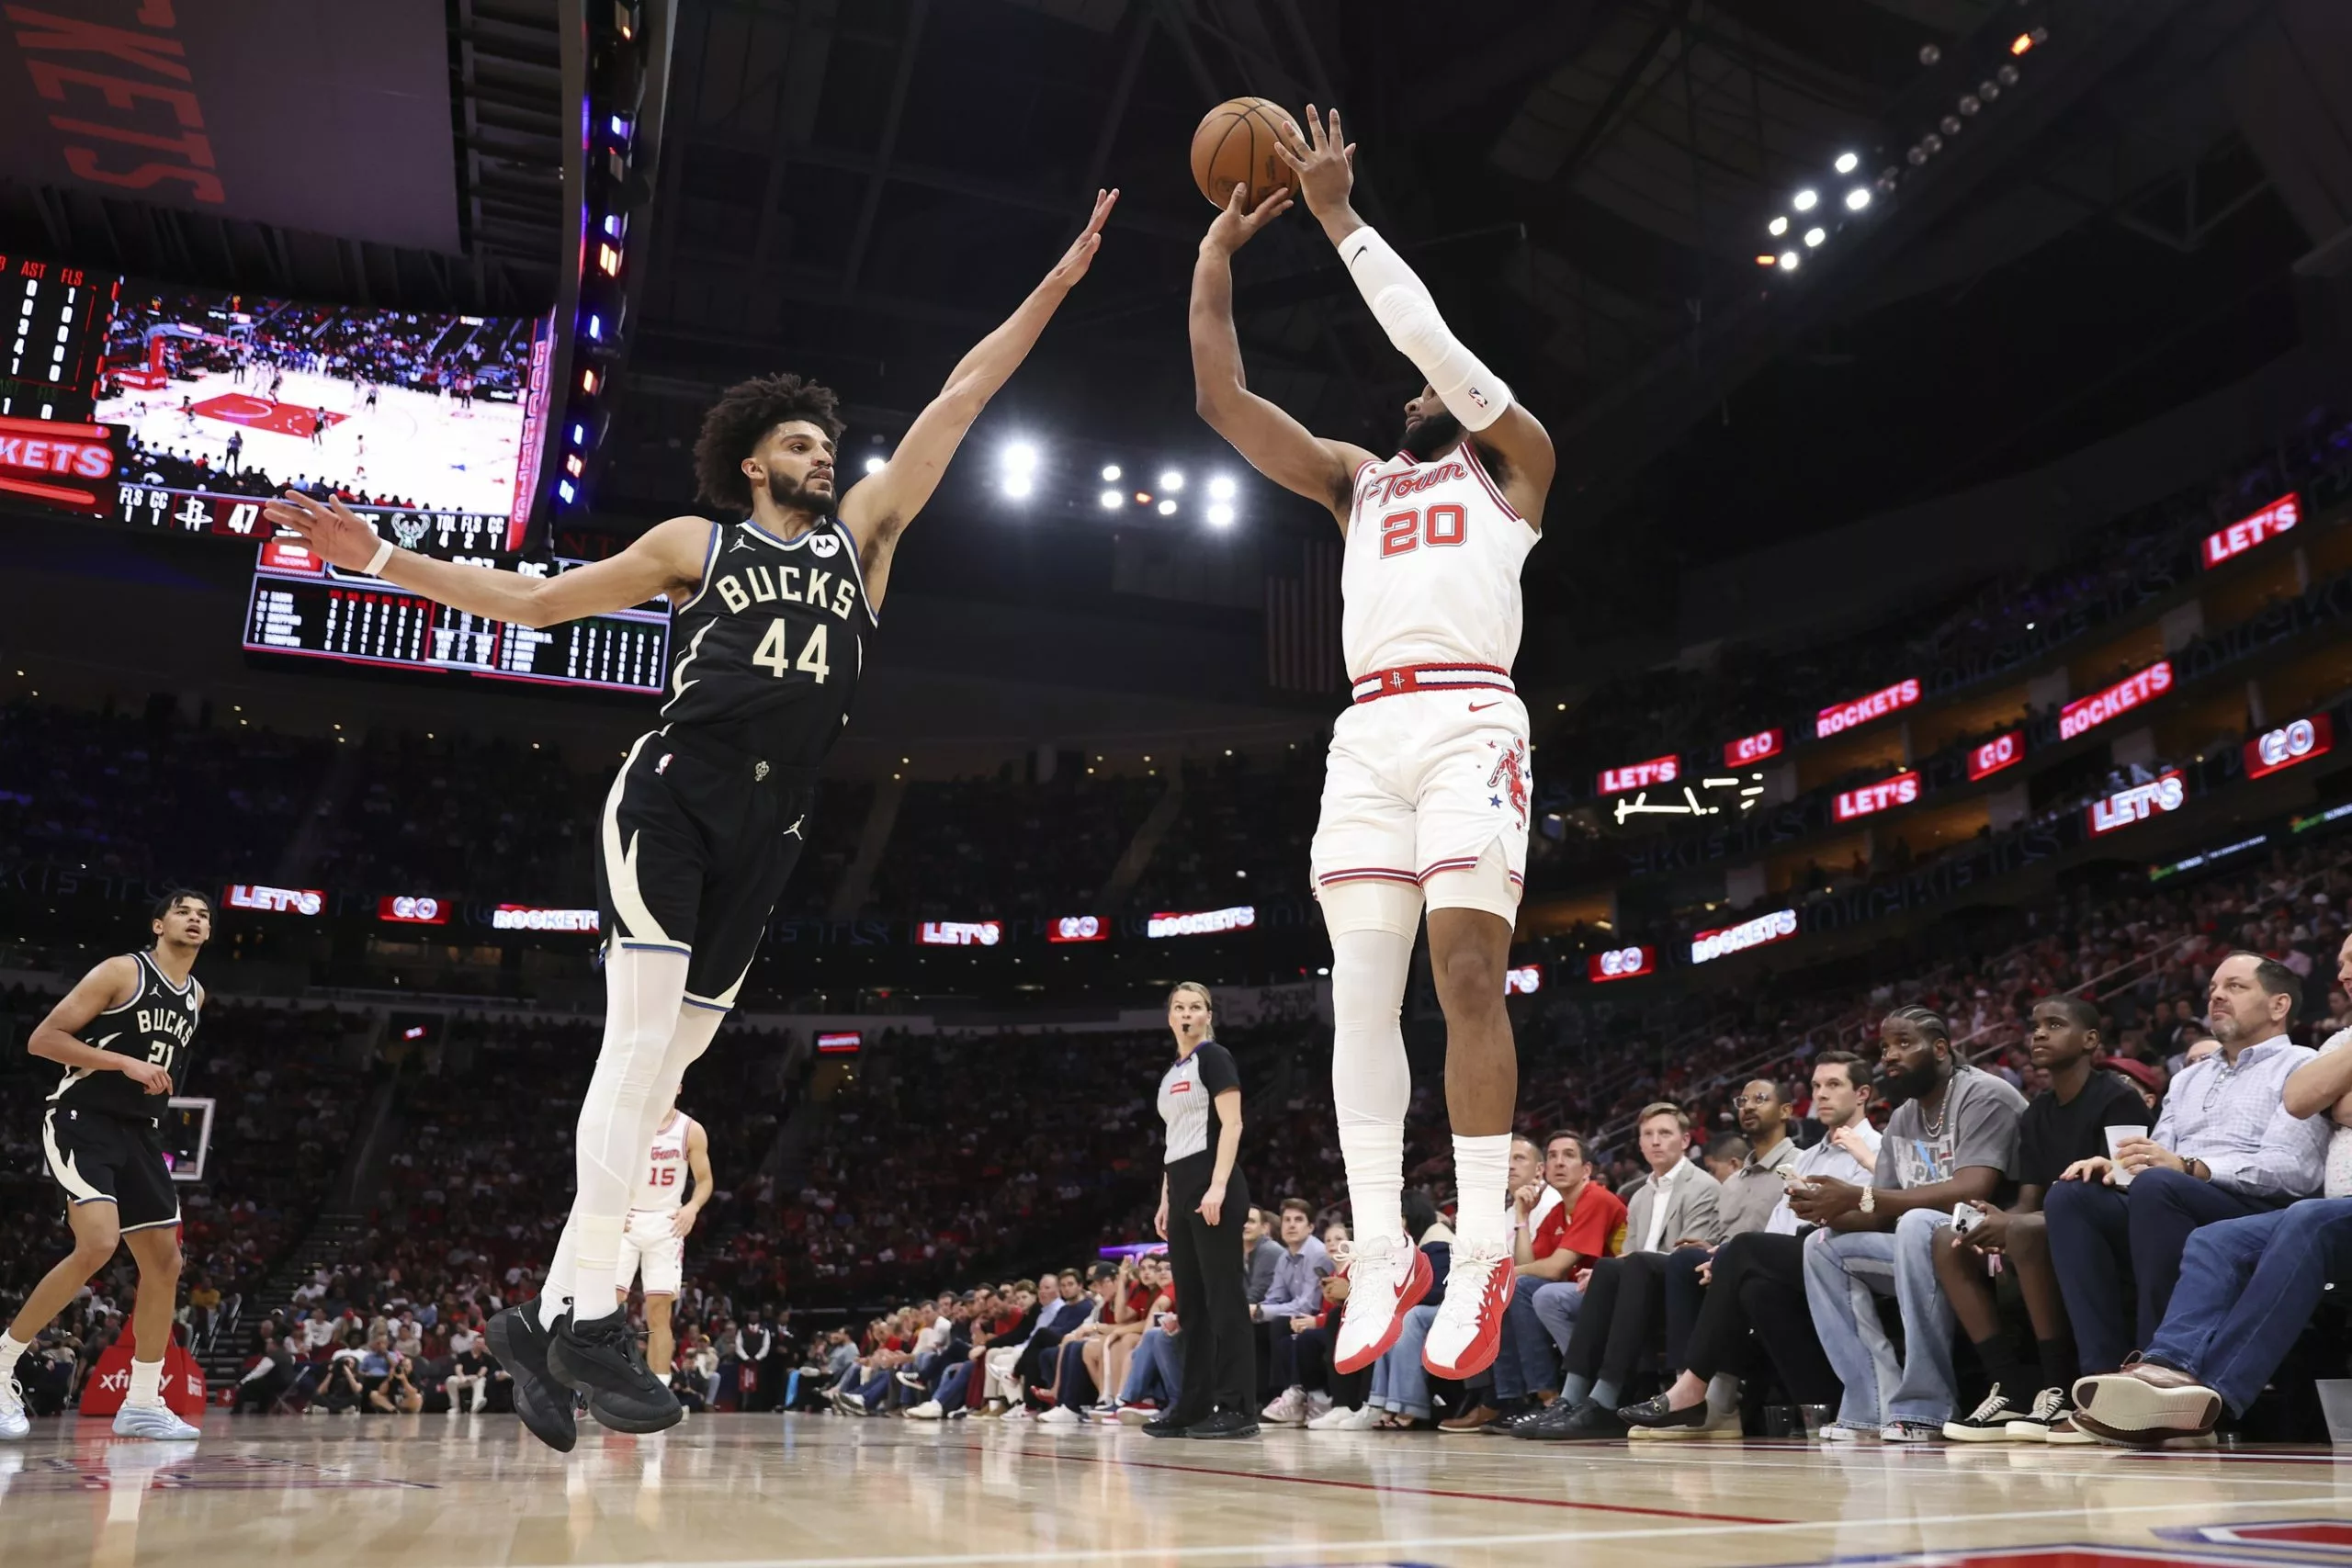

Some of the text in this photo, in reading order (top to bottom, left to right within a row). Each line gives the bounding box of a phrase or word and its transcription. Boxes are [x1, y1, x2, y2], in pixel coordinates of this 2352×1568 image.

[20, 260, 47, 279] AST
[61, 267, 84, 287] FLS
[119, 487, 143, 506] FLS
[227, 502, 259, 535] 47
[460, 515, 482, 535] FLS
[1380, 502, 1467, 559] 20
[2209, 502, 2297, 562] LET'S
[716, 566, 855, 621] BUCKS
[752, 618, 830, 684] 44
[1602, 677, 1920, 792] LET'S GO ROCKETS
[1838, 660, 2173, 819] LET'S GO ROCKETS
[2093, 718, 2315, 832] LET'S GO
[231, 884, 322, 916] LET'S
[392, 896, 437, 919] GO
[922, 921, 1001, 946] LET'S
[1058, 916, 1099, 939] GO
[1600, 946, 1644, 976] GO
[137, 1009, 195, 1048] BUCKS
[148, 1040, 175, 1072] 21
[649, 1168, 676, 1187] 15
[99, 1368, 174, 1393] xfiy
